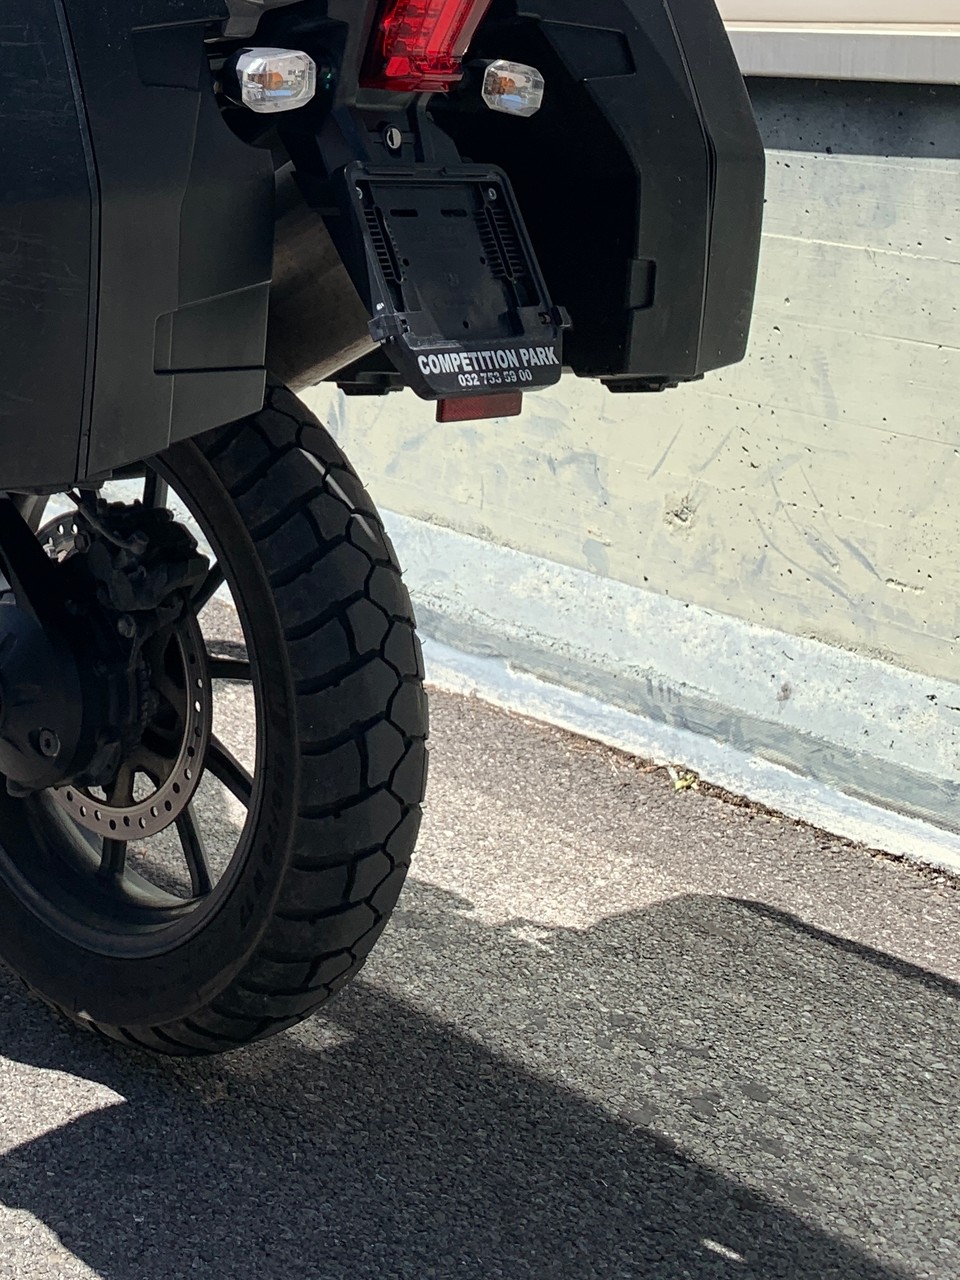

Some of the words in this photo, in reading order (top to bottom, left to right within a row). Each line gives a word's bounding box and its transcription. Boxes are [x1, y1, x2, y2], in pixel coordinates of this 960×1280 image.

[417, 349, 520, 375] COMPETITION
[518, 346, 560, 367] PARK
[457, 373, 481, 387] 032
[480, 371, 502, 385] 753
[503, 369, 518, 383] 59
[518, 368, 533, 382] 00
